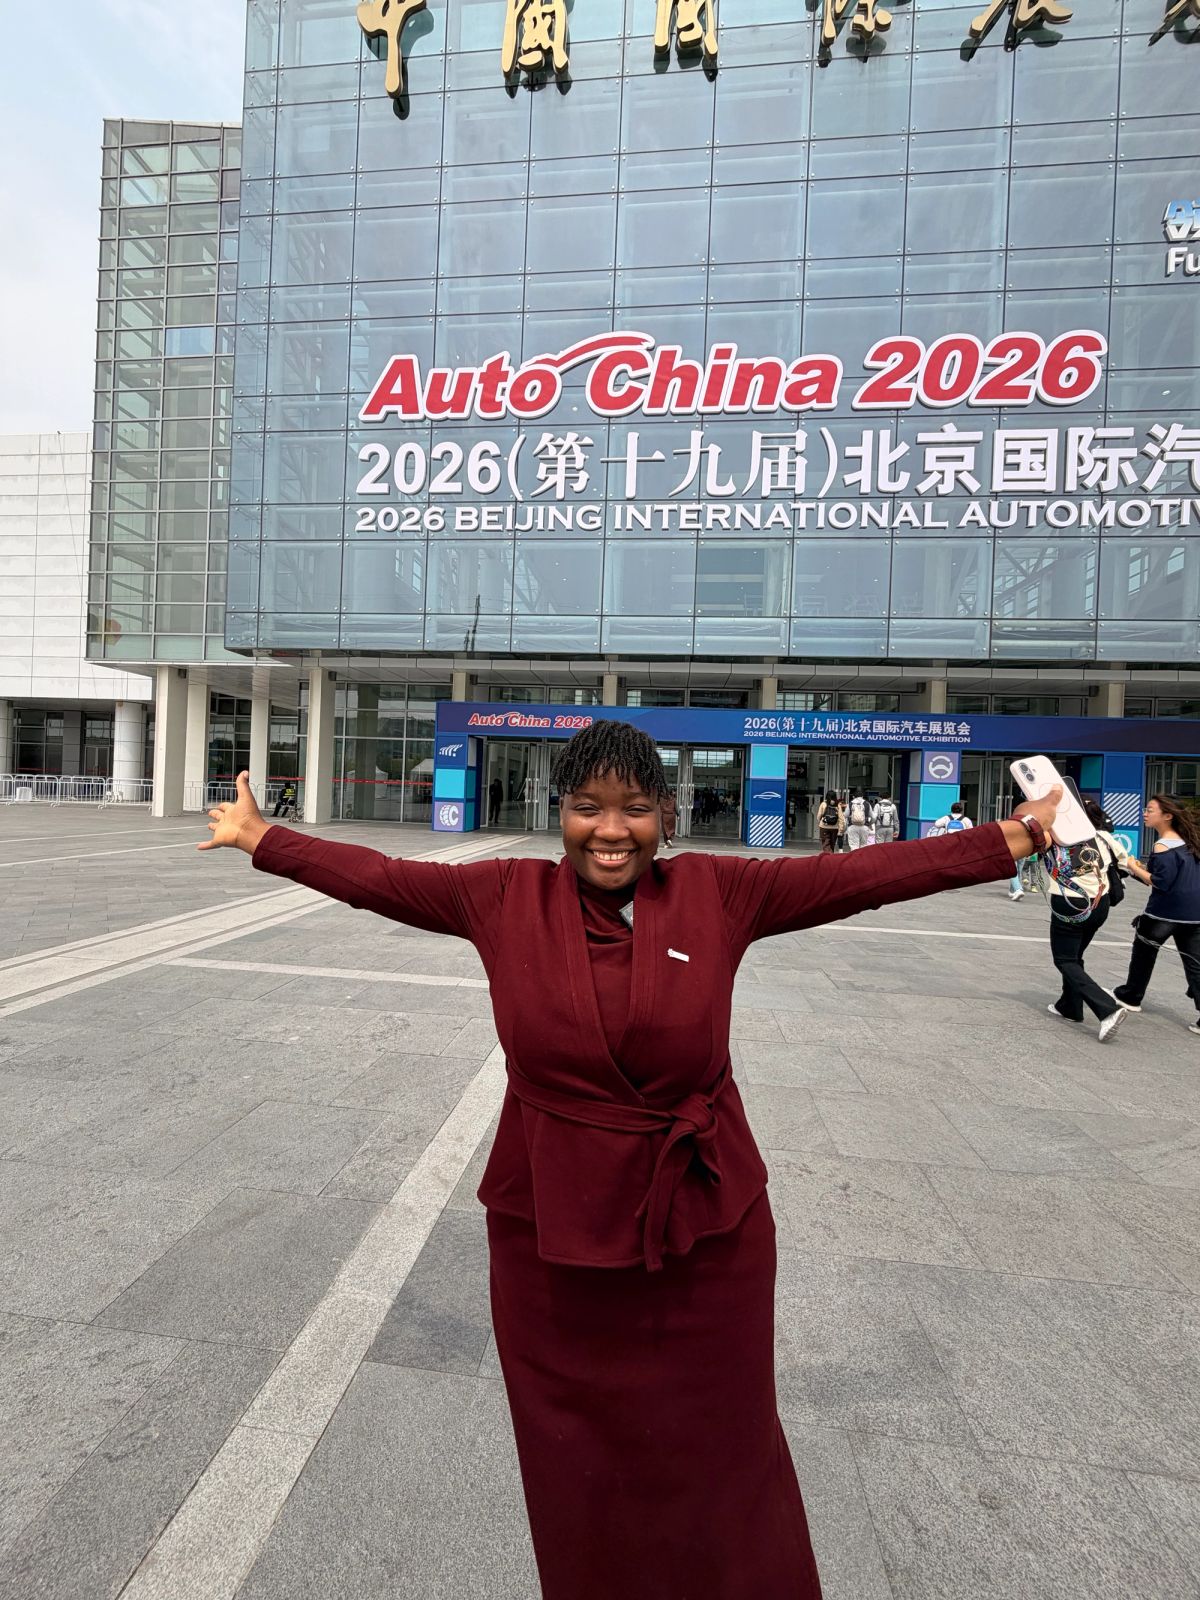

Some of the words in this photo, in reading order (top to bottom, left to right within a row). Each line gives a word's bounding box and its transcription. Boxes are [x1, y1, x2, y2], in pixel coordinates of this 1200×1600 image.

[359, 351, 563, 421] Auto
[585, 331, 843, 414] China
[852, 329, 1108, 409] 2026
[356, 423, 1200, 501] 2026(第十九届)北京国际汽
[355, 505, 446, 532] 2026
[455, 504, 602, 532] BEIJING
[614, 501, 949, 531] INTERNATIONAL
[467, 713, 505, 726] Auto
[507, 712, 550, 727] China
[553, 715, 592, 728] 2026
[744, 716, 971, 736] 2026(第十九届)北京国际汽车展览会
[799, 732, 866, 740] INTERNATIONAL
[866, 734, 921, 742] AUTOMOTIVE
[922, 735, 971, 743] EXHIBITION
